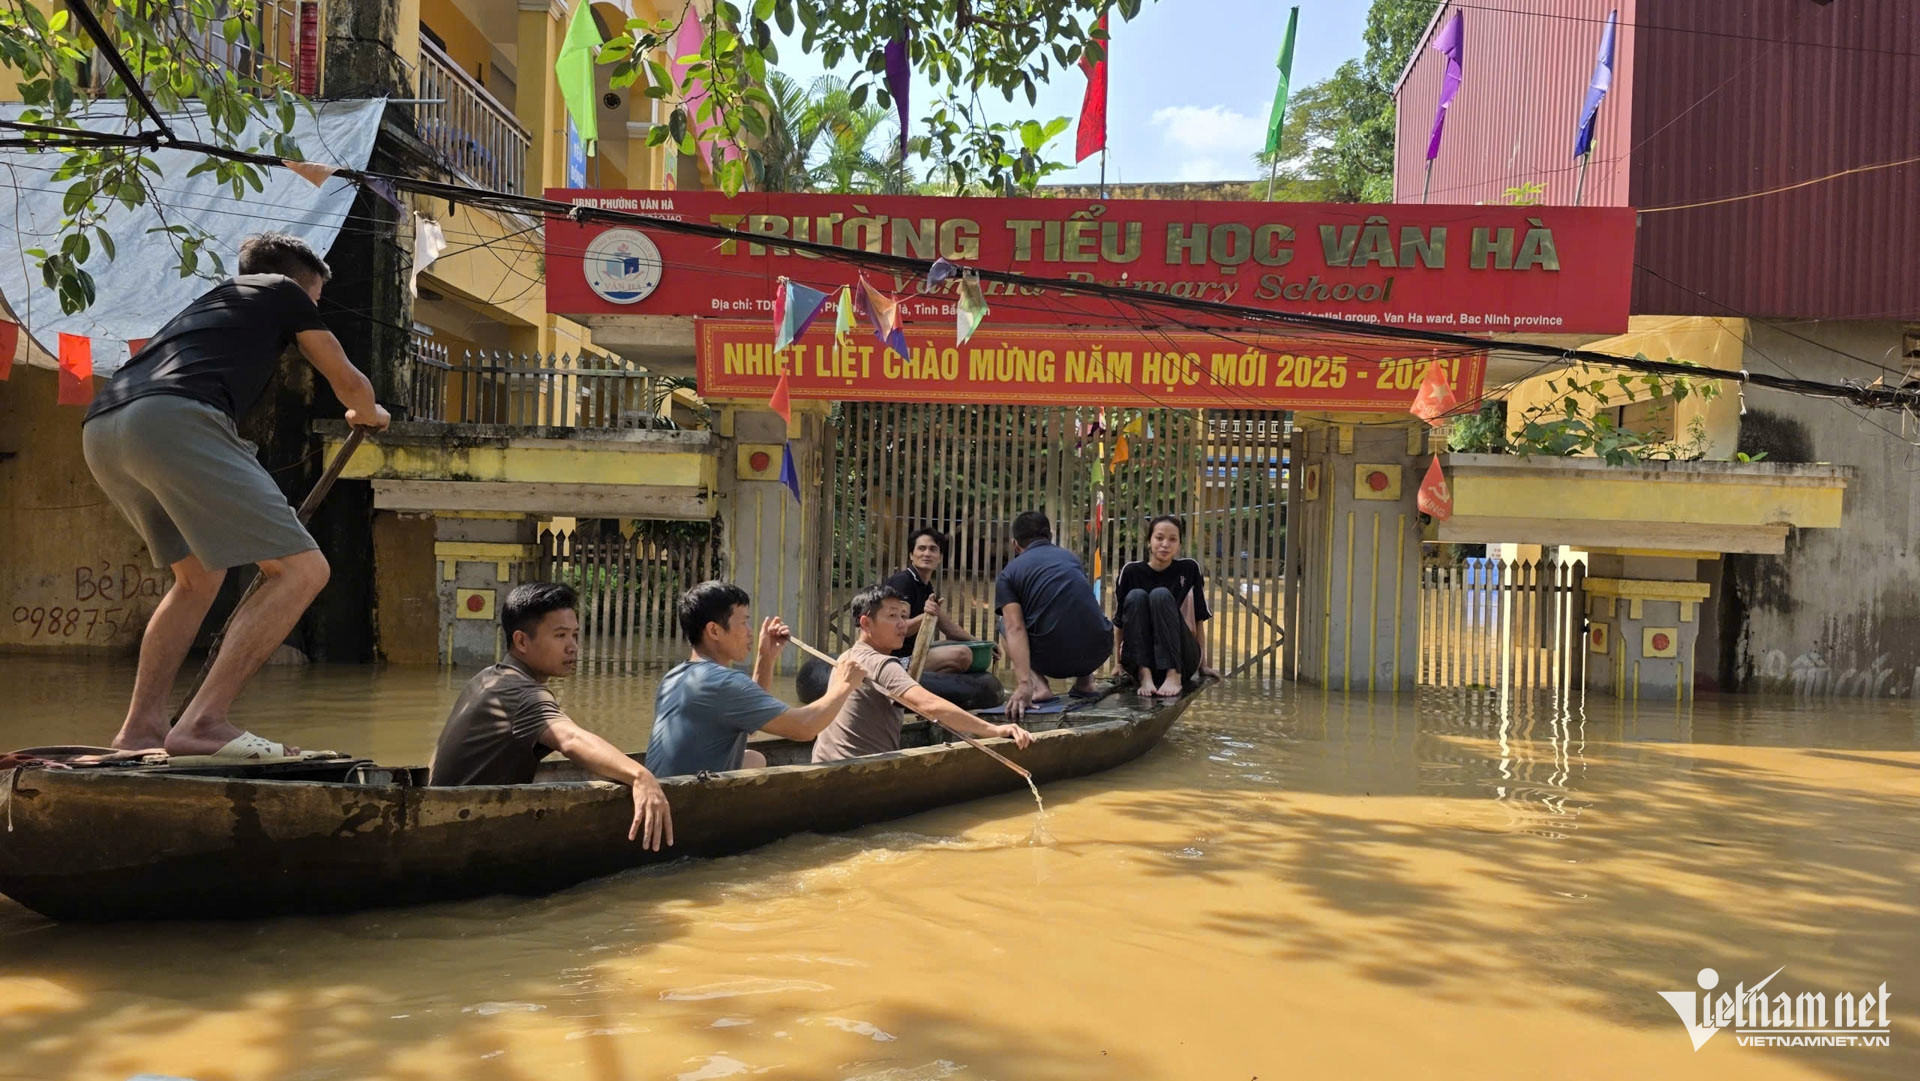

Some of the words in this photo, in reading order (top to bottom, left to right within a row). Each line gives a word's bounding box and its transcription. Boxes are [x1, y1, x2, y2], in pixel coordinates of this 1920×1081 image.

[572, 198, 597, 209] UBND
[600, 196, 638, 210] PHƯỜNG
[640, 198, 659, 210] VÂN
[661, 197, 674, 210] HÀ
[710, 204, 980, 260] TRƯỜNG
[1006, 204, 1142, 263] TIỂU
[1166, 222, 1295, 274] HỌC
[1319, 215, 1447, 269] VÂN
[1470, 218, 1561, 271] HÀ
[1254, 274, 1395, 302] School
[711, 298, 730, 311] Địa
[732, 298, 753, 311] chỉ:
[914, 303, 939, 315] Tỉnh
[941, 303, 958, 316] Bắ
[1383, 312, 1404, 323] Van
[1408, 313, 1423, 323] Ha
[1426, 314, 1457, 325] ward,
[1460, 313, 1481, 324] Bac
[1484, 314, 1511, 325] Ninh
[1513, 315, 1563, 327] province
[816, 338, 874, 385] LIỆT
[883, 340, 959, 380] CHÀO
[968, 342, 1056, 383] MỪNG
[1065, 344, 1133, 384] NĂM
[1142, 351, 1201, 393] HỌC
[1210, 346, 1268, 387] MỚI
[1275, 354, 1348, 389] 2025
[1357, 370, 1369, 379] -
